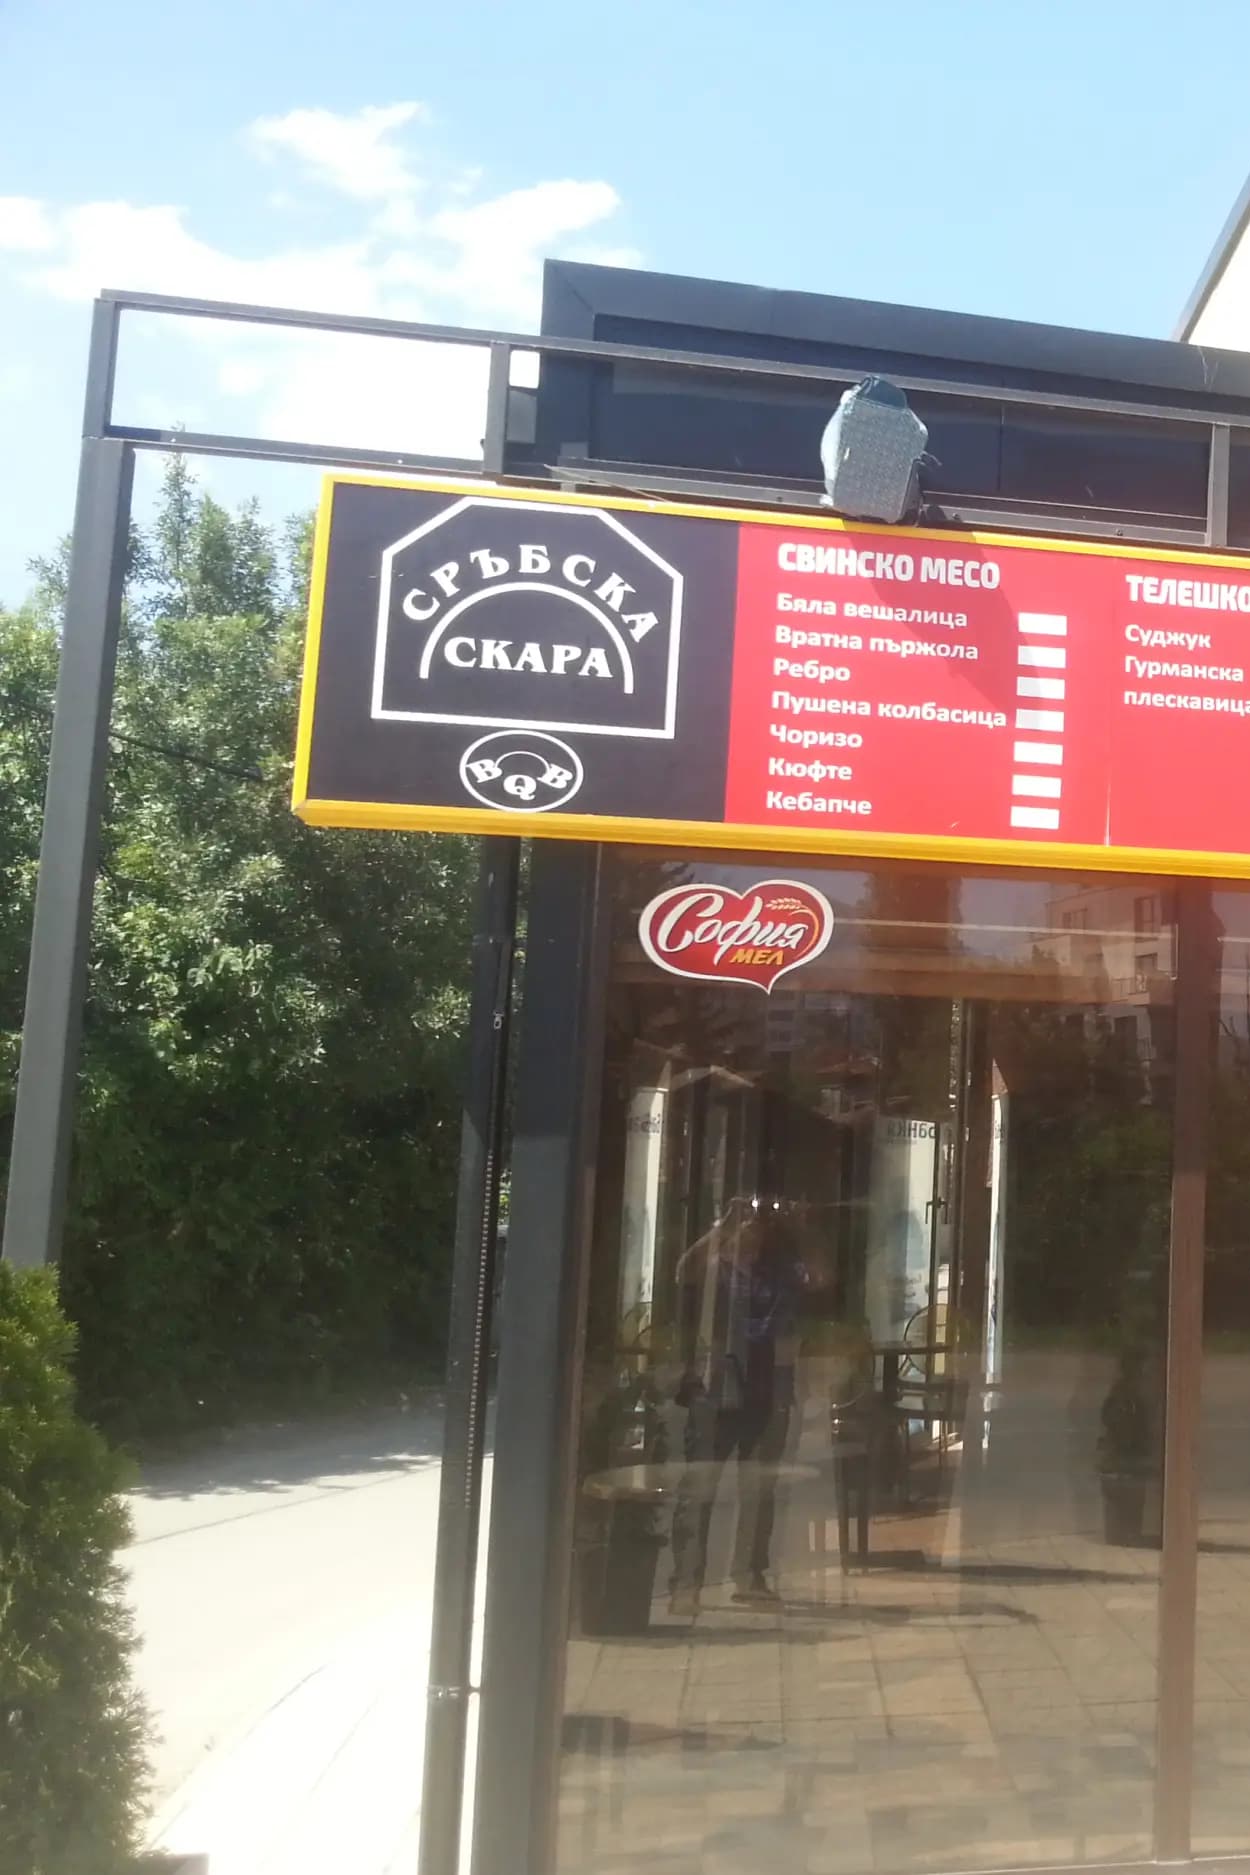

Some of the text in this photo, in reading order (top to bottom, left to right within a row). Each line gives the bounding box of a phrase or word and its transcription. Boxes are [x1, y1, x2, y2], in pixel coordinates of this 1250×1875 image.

[777, 542, 1000, 589] СВИНСКО МЕСО
[402, 544, 659, 643] СРЪБСКА
[776, 592, 968, 629] Бяла вешалица
[775, 625, 978, 660] Вратна пържола
[1124, 624, 1211, 651] Суджук
[443, 636, 613, 678] СКАРА
[773, 657, 851, 684] Ребро
[1124, 655, 1244, 682] Гурманска
[771, 690, 1007, 729] Пушена колбасица
[769, 723, 863, 748] Чоризо
[768, 757, 853, 782] Кюфте
[766, 790, 872, 815] Кебапче
[657, 892, 809, 966] София
